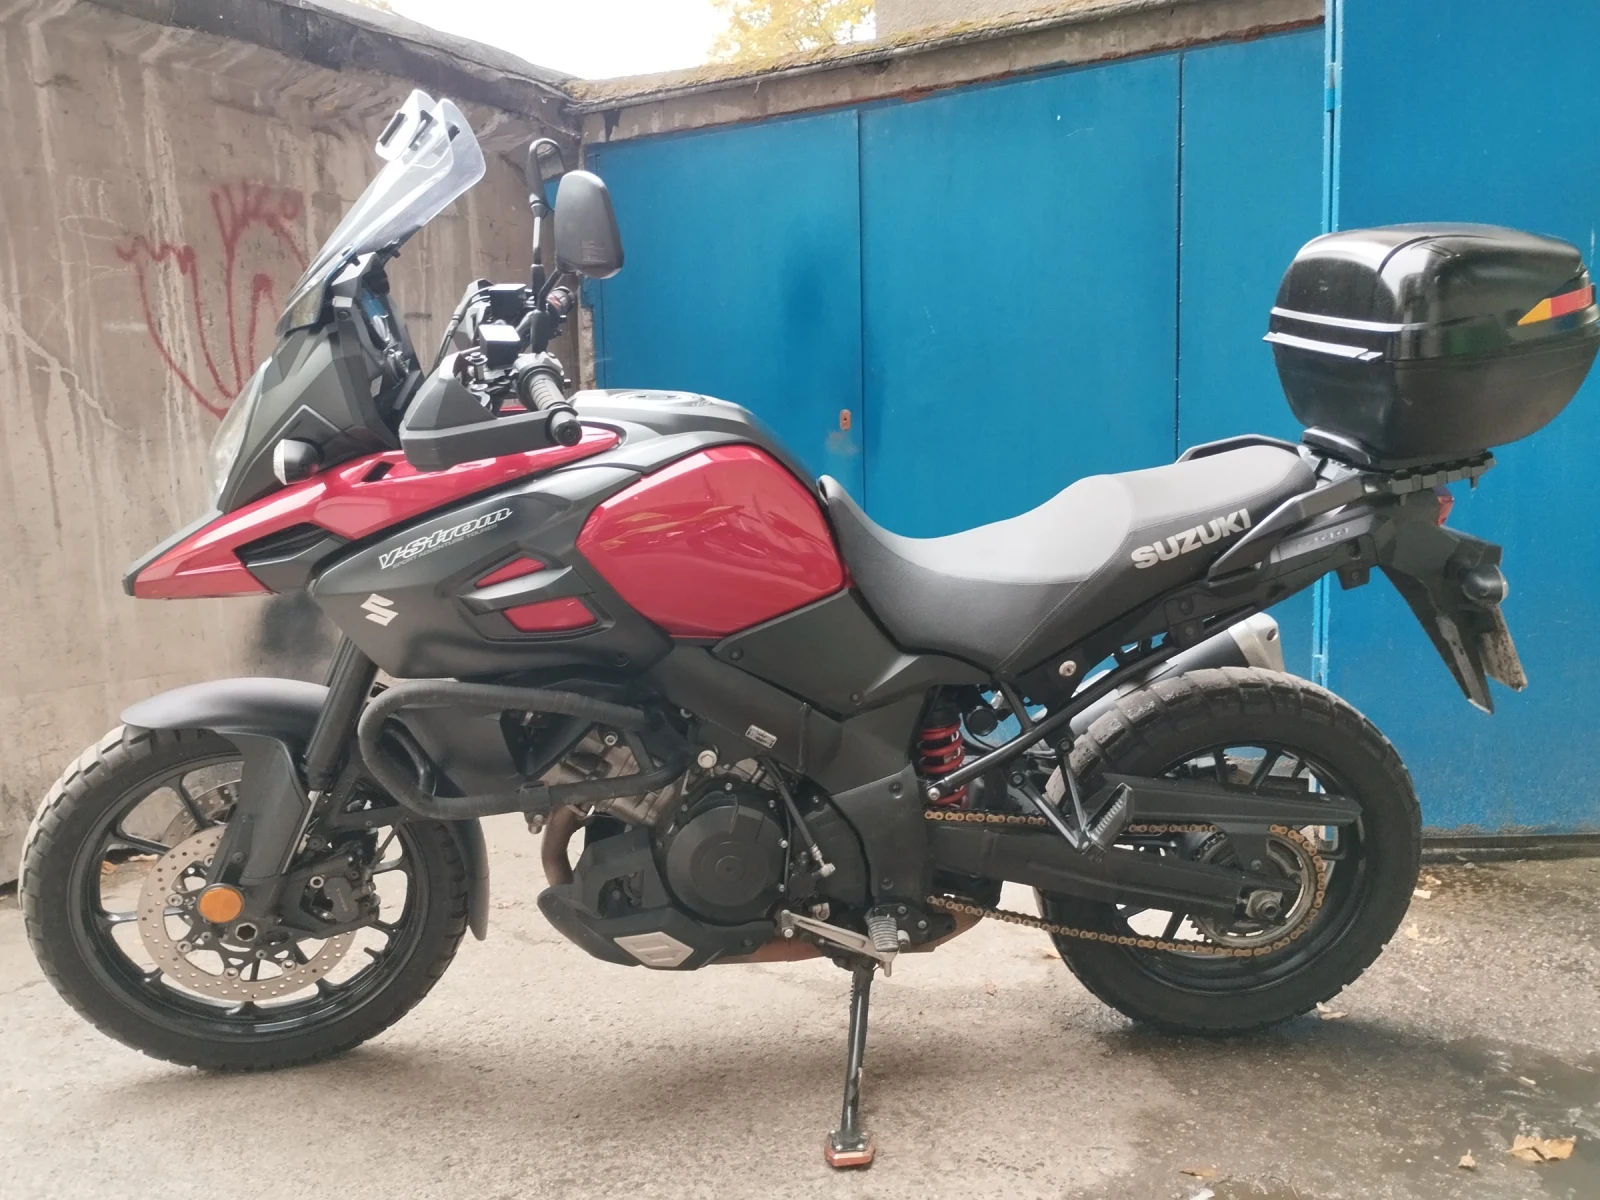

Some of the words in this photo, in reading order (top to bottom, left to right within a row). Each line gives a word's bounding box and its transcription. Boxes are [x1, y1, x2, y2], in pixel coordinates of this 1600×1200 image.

[379, 508, 513, 569] V-Strom
[392, 555, 418, 569] SPORT
[419, 537, 464, 558] ADVENTURE
[466, 523, 497, 538] TOURER
[1131, 508, 1251, 569] SUZUKI
